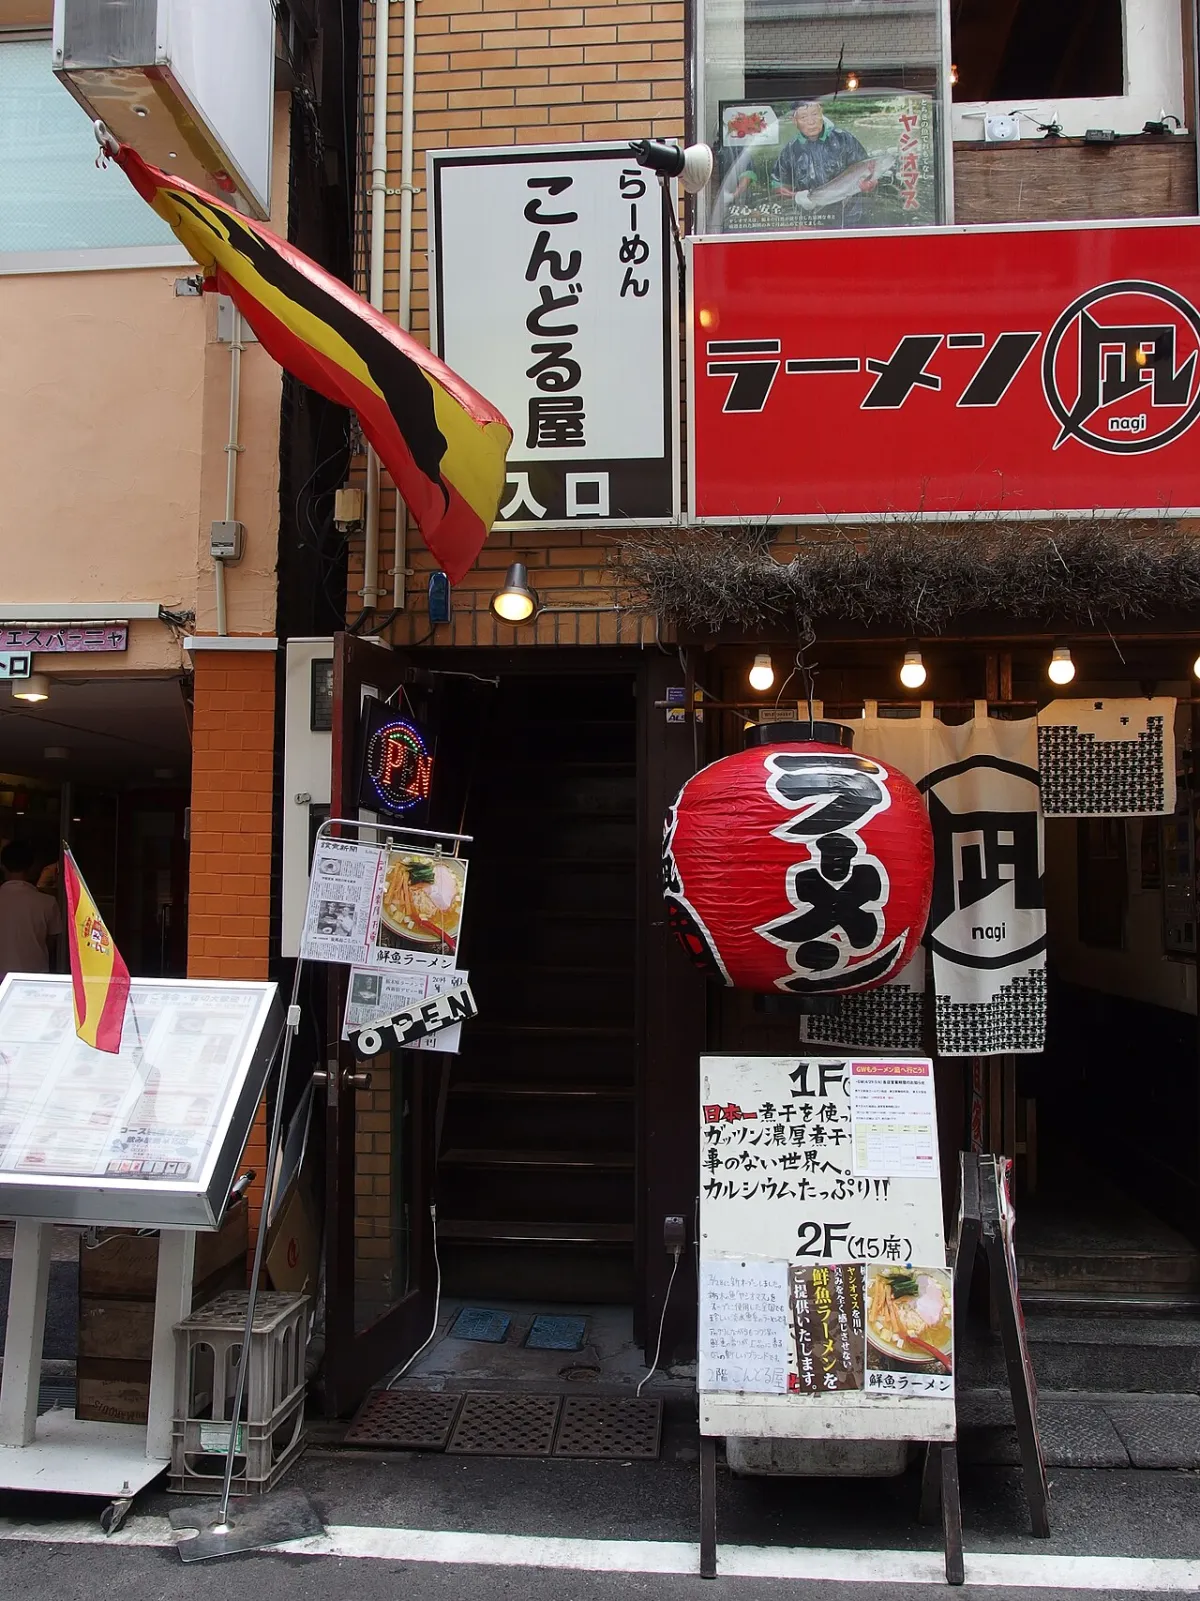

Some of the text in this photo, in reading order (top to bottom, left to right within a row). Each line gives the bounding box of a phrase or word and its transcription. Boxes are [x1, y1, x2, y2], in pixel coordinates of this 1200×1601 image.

[898, 113, 920, 210] ヤシオマス
[618, 168, 651, 299] らーめん
[523, 175, 587, 450] こんどる屋
[706, 331, 1042, 413] ラーメン
[1108, 413, 1147, 433] nagi
[499, 470, 611, 520] 入口
[0, 628, 124, 648] エスパーニャ
[752, 752, 910, 994] ラーメン
[375, 949, 453, 970] 鮮魚ラーメン
[971, 922, 1007, 943] nagi
[357, 989, 475, 1055] OPEN
[701, 1147, 852, 1177] 事のない世界へ。
[793, 1268, 818, 1390] ご提供いたします。
[812, 1266, 839, 1390] 鮮魚ラーメンを
[868, 1373, 952, 1393] 鮮魚ラーメン
